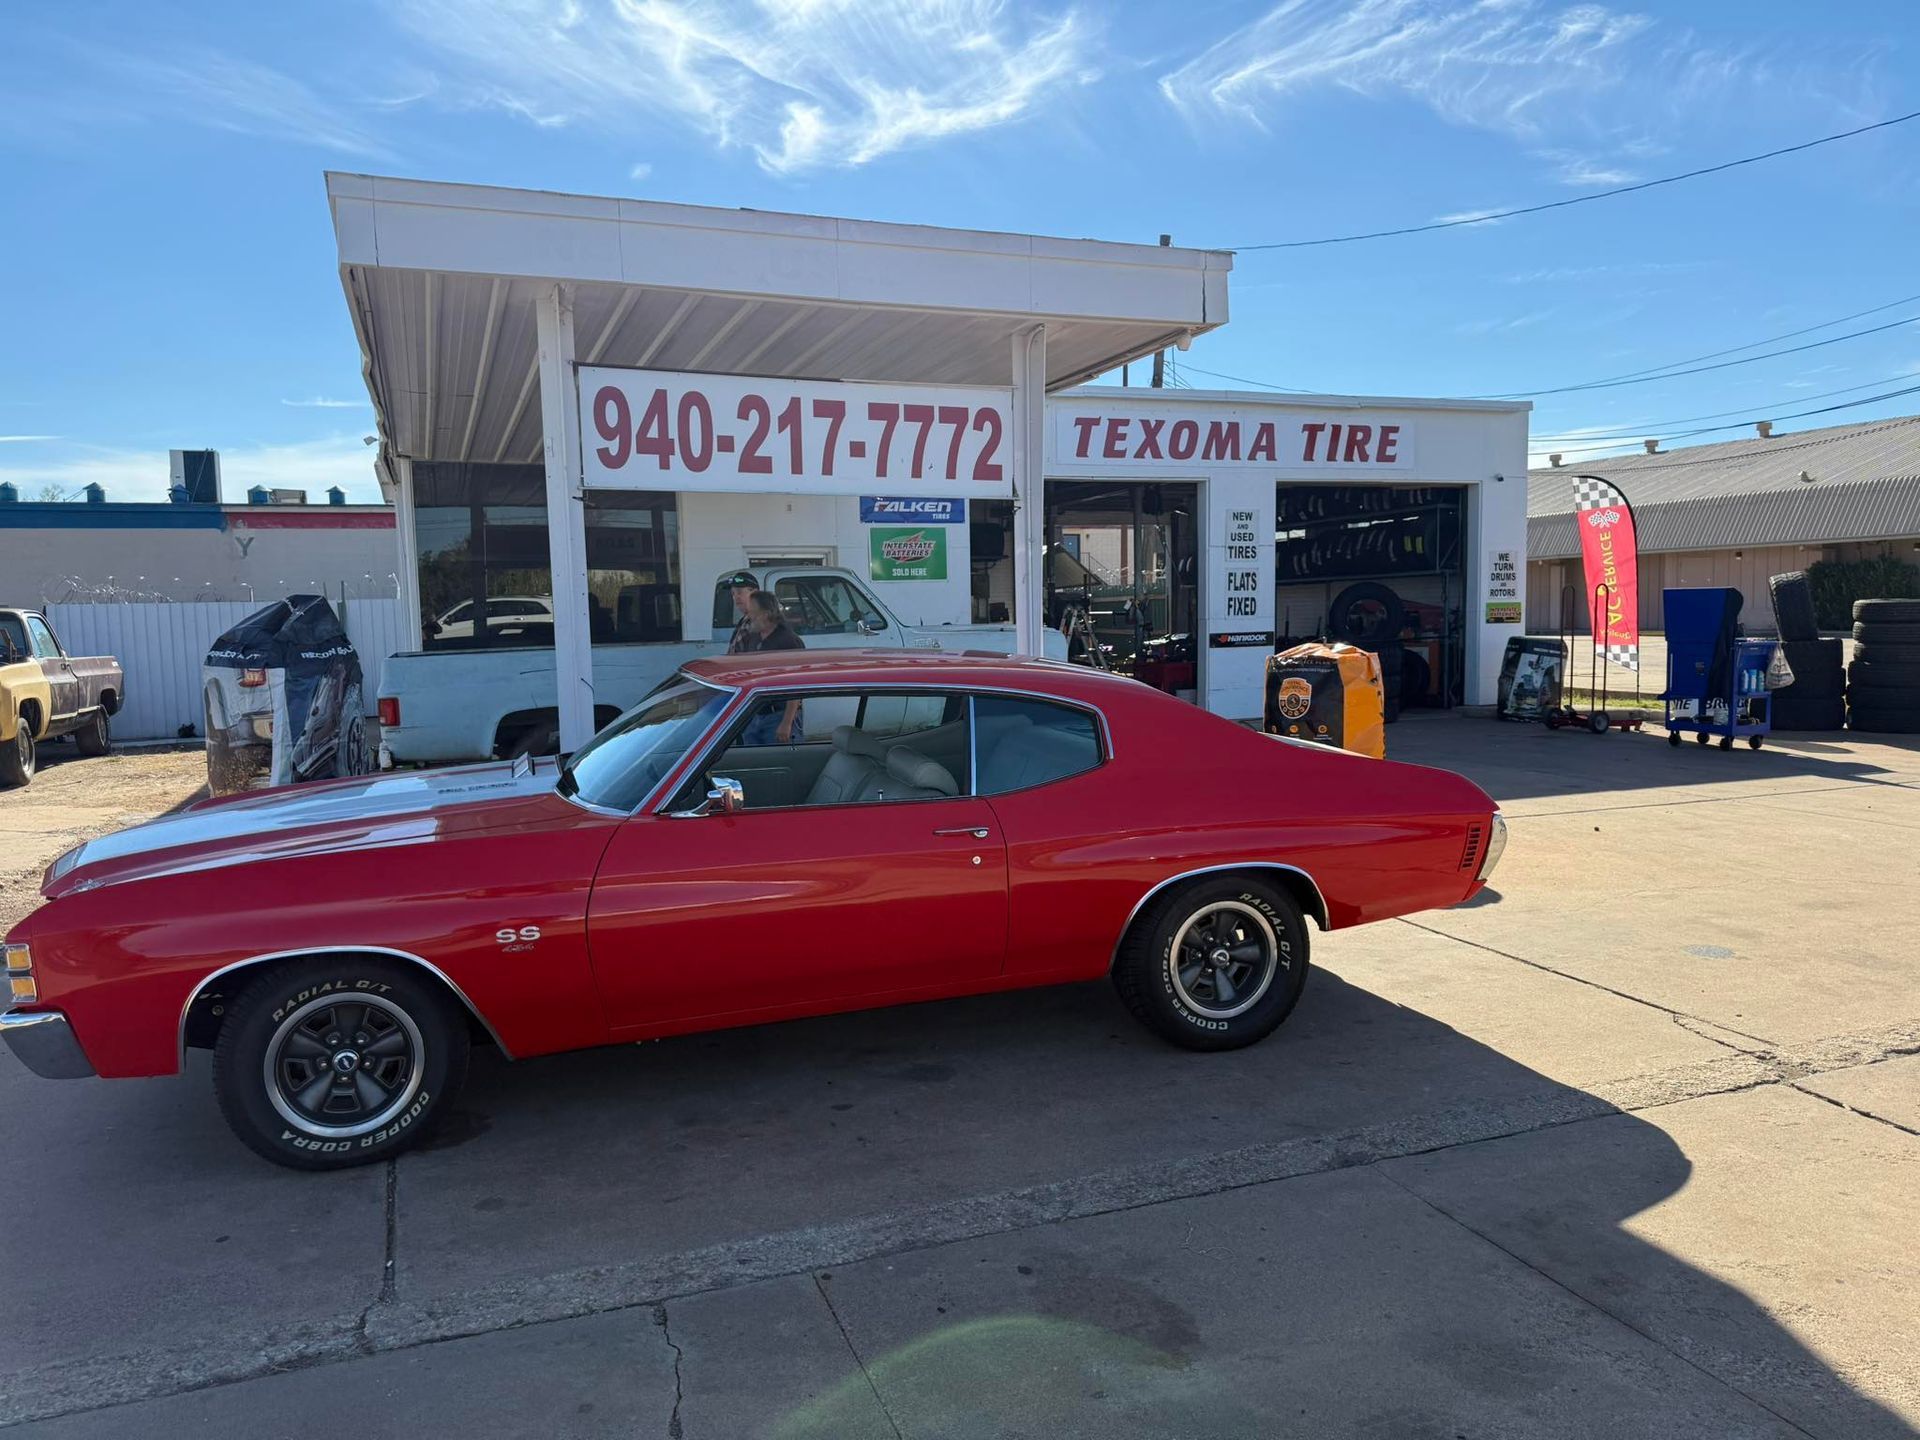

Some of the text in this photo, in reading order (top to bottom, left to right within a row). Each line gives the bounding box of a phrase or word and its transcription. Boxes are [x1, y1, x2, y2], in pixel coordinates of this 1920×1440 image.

[593, 385, 1003, 482] 940-217-7772
[1073, 415, 1401, 463] TEXOMA TIRE
[873, 501, 952, 513] FALKEN
[1232, 511, 1253, 521] NEW
[1230, 532, 1254, 542] USED
[884, 541, 934, 550] INTERSTATE
[1227, 545, 1257, 559] TIRES
[885, 549, 930, 557] BATTERIES
[1498, 552, 1510, 562] WE
[892, 567, 927, 577] SOLD HERE
[1493, 562, 1514, 571] TURN
[1227, 572, 1257, 591] FLATS
[1490, 572, 1516, 582] DRUMS
[1489, 588, 1516, 597] ROTORS
[1227, 597, 1257, 616] FIXED
[1239, 893, 1286, 935] RADIAL
[495, 926, 541, 943] SS
[272, 980, 393, 1022] RADIAL G/T
[1172, 998, 1229, 1030] COOPER
[281, 1091, 430, 1152] COOPER COBRA
